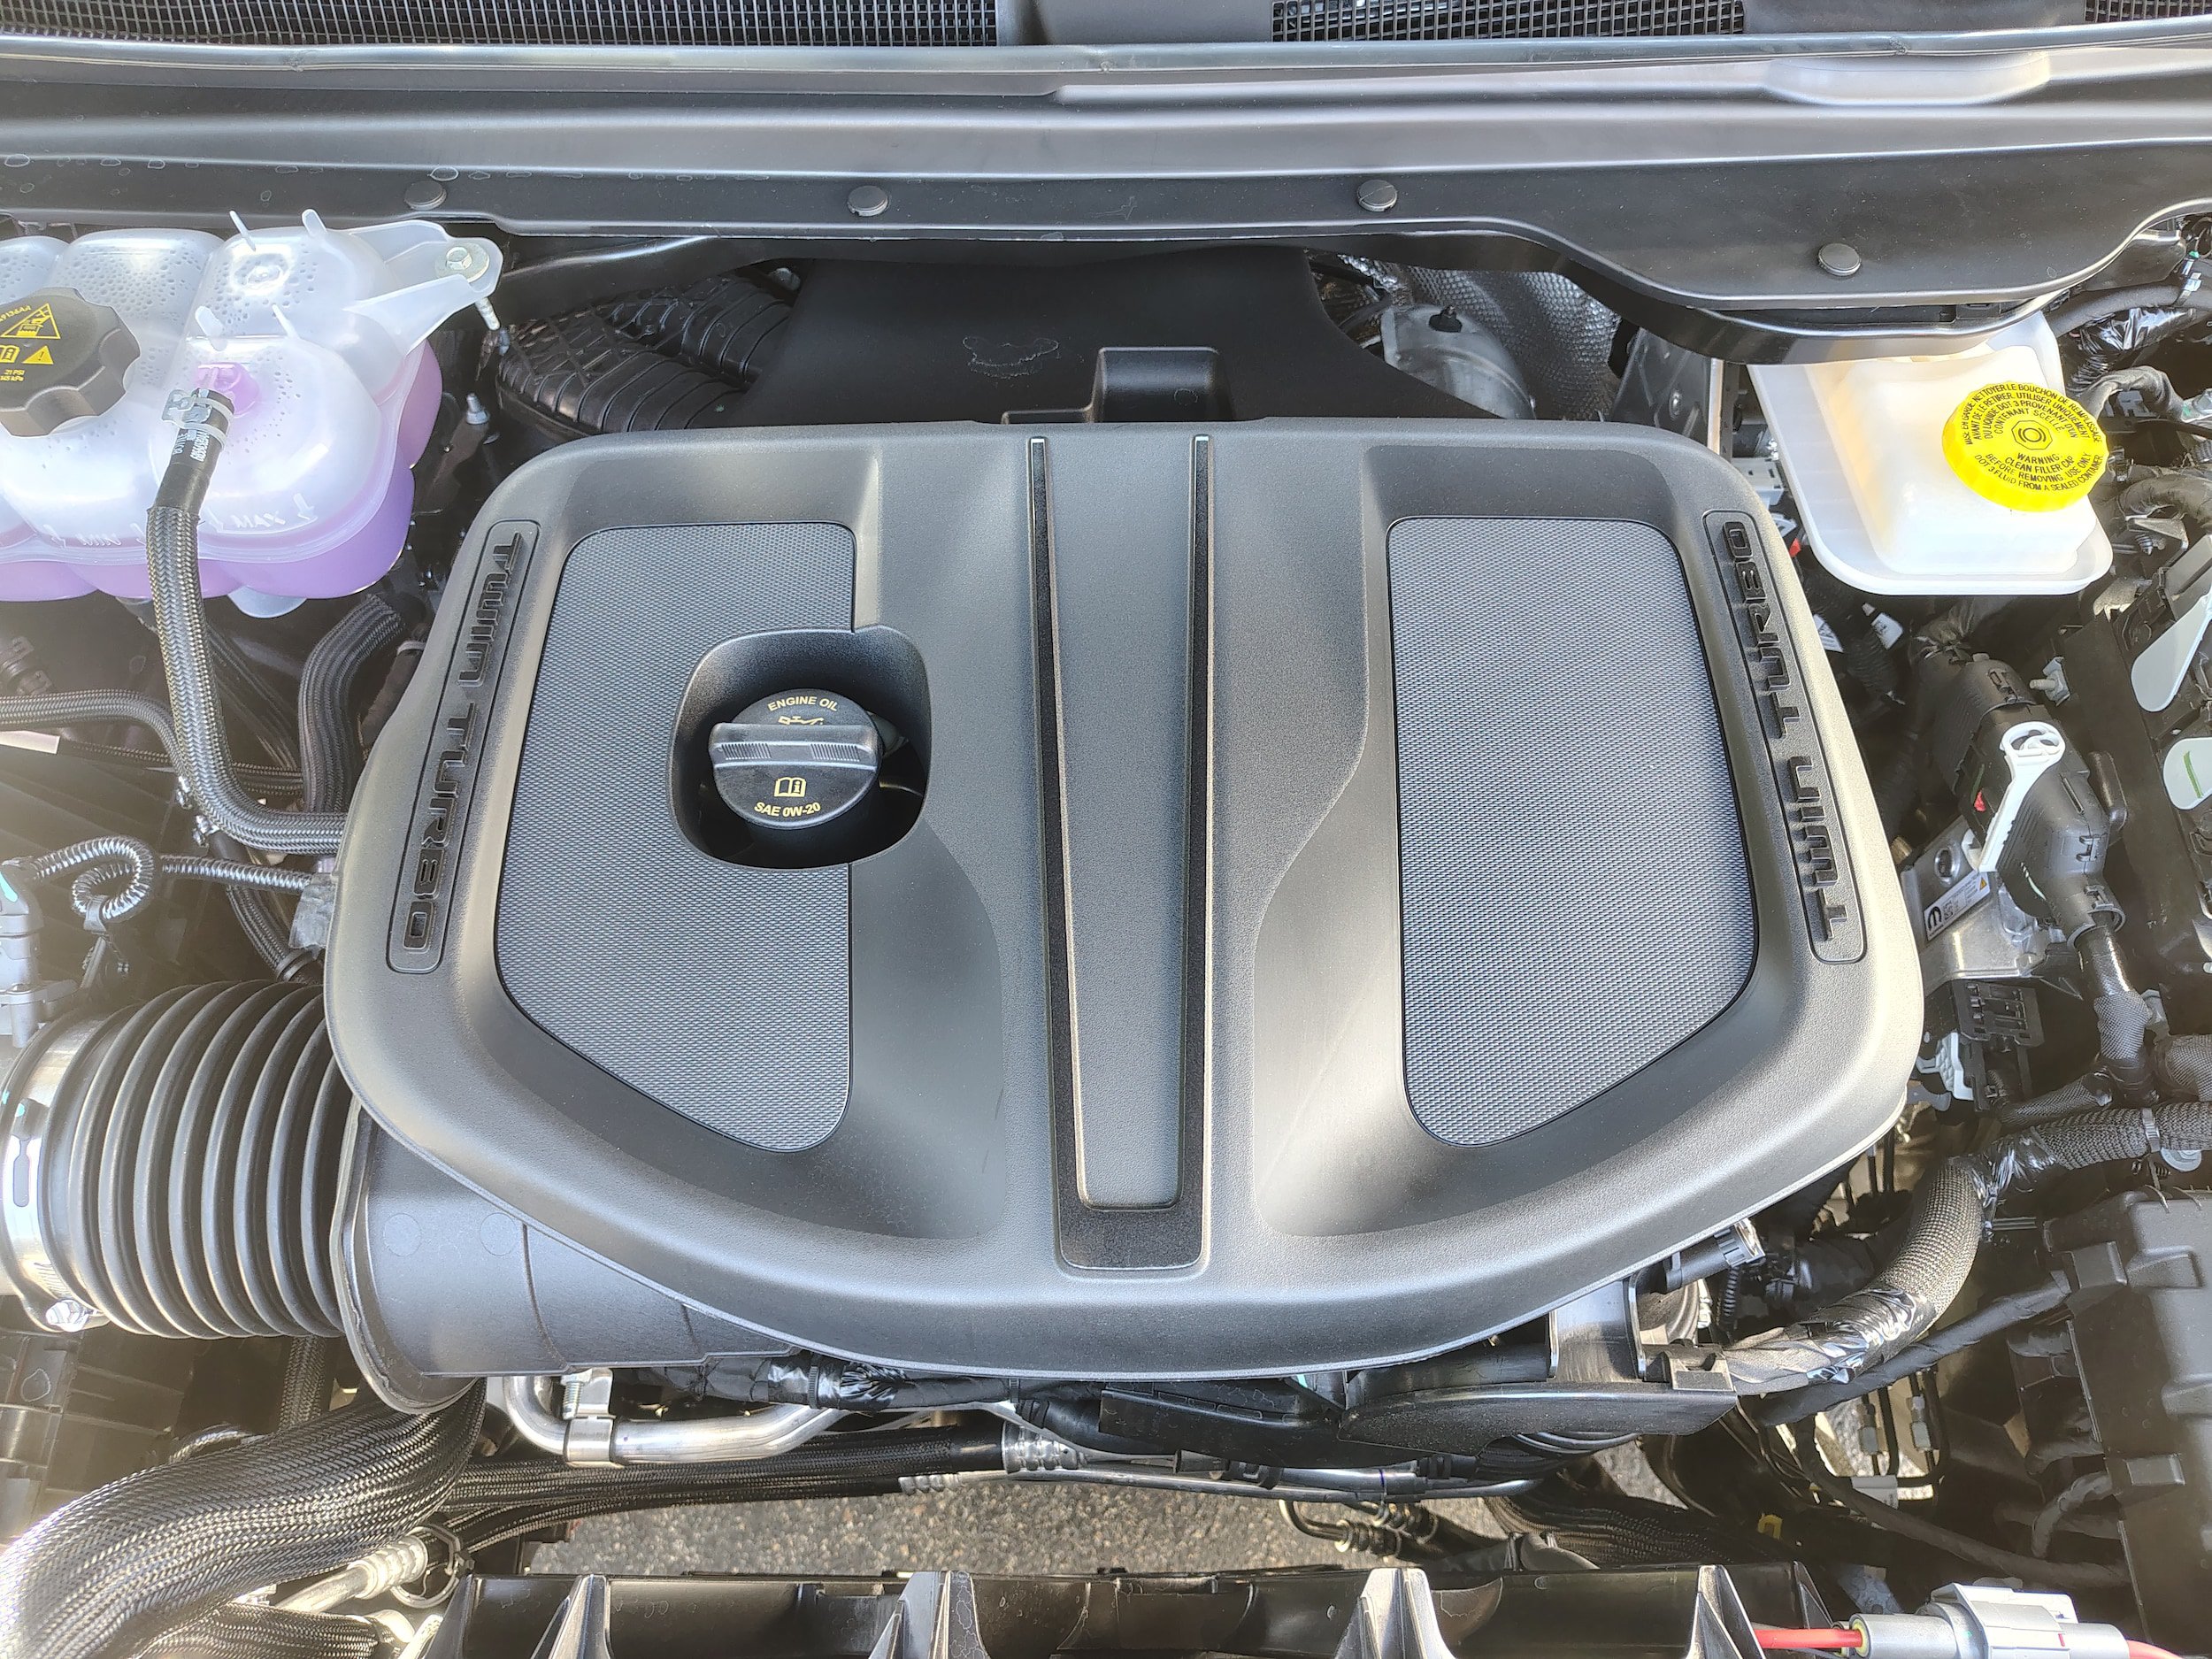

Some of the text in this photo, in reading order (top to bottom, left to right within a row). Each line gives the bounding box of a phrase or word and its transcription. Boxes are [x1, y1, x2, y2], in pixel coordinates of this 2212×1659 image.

[1977, 403, 1987, 413] LE
[1996, 401, 2012, 411] DOT
[2016, 392, 2052, 405] UTILISER
[1961, 421, 1969, 430] EN
[1972, 384, 2007, 403] NETTOYER
[2018, 383, 2058, 399] BOUCHON
[2058, 396, 2070, 405] DE
[2069, 403, 2102, 442] REMPLISSAGE
[1972, 411, 1983, 420] DE
[1982, 408, 2000, 430] LIQUIDE
[1993, 408, 2030, 434] CONTENANT
[2019, 399, 2068, 423] PROVENANT
[2052, 402, 2090, 438] UNIQUEMENT
[1970, 420, 1983, 440] AVANT
[1982, 430, 1993, 440] DU
[1974, 454, 1991, 467] DOT
[1993, 469, 2016, 484] FLUID
[2018, 480, 2041, 490] FROM
[2050, 480, 2079, 491] SEALED
[2077, 454, 2103, 483] CONTAINER
[1985, 453, 2016, 476] BEFORE
[2065, 465, 2081, 478] USE
[2077, 451, 2091, 469] ONLY
[2005, 455, 2074, 473] CLEAN FILLER CAP
[767, 695, 840, 711] ENGINE OIL
[1722, 520, 1848, 941] TWIN TURBO
[403, 532, 523, 952] TWIN TURBO
[754, 802, 821, 818] SAE 0W-20
